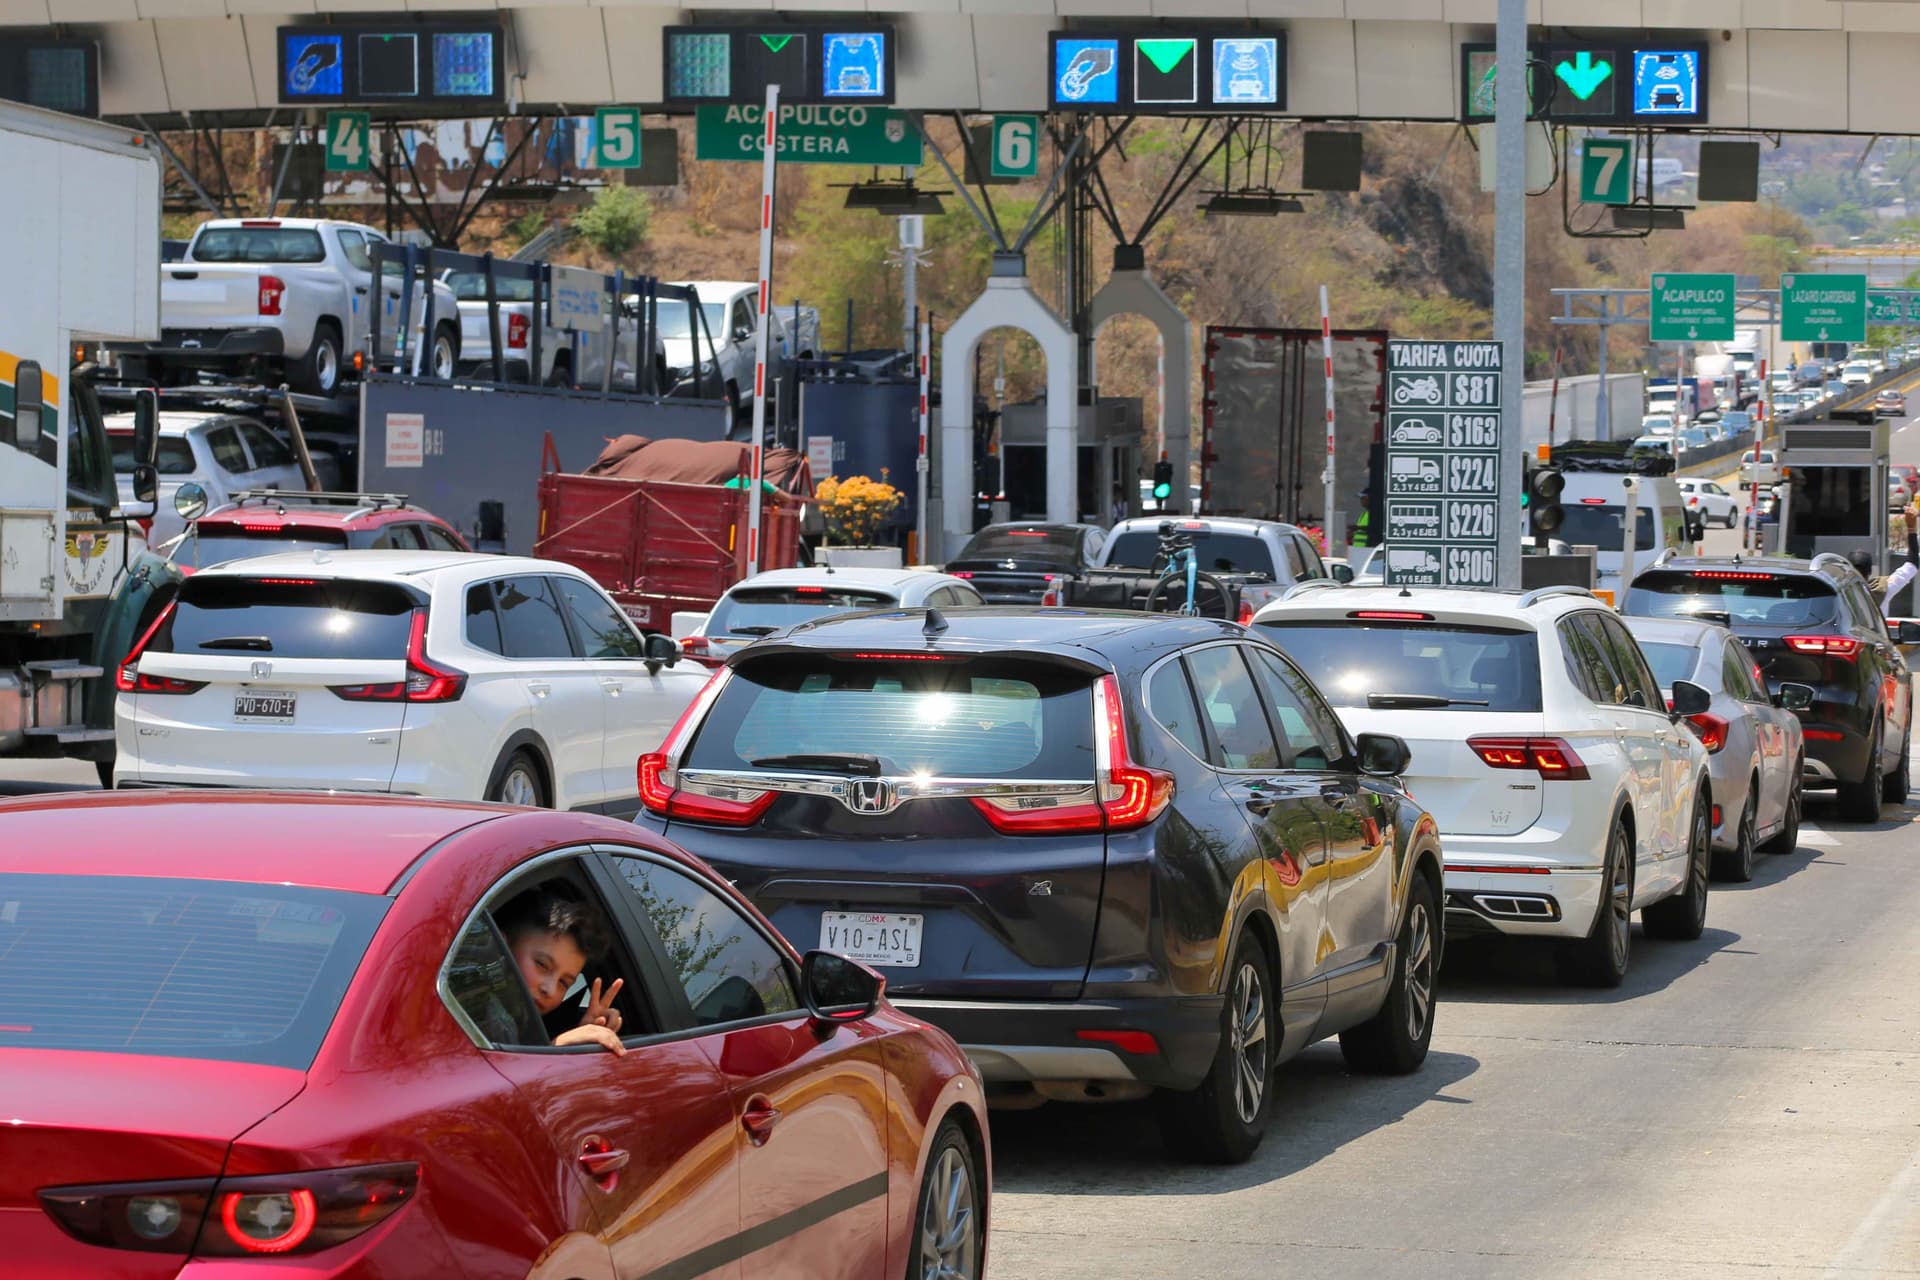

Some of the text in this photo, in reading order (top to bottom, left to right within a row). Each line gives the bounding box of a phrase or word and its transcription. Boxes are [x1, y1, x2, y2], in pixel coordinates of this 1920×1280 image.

[332, 118, 362, 165] 4
[603, 114, 634, 160] 5
[999, 121, 1032, 168] 6
[1589, 146, 1624, 196] 7
[1662, 289, 1725, 303] ACAPULCO
[1390, 345, 1500, 367] TARIFA CUOTA
[1455, 374, 1494, 405] $81
[1451, 415, 1496, 446] $163
[1401, 483, 1407, 491] 3
[1420, 483, 1439, 491] EJES
[1450, 456, 1494, 492] $224
[1400, 528, 1406, 536] 3
[1412, 528, 1418, 536] 4
[1419, 528, 1438, 537] EJES
[1450, 502, 1494, 537] $226
[1401, 575, 1408, 583] Y
[1414, 575, 1433, 583] EJES
[1449, 548, 1493, 584] $306
[235, 698, 294, 714] PVD-670-E
[858, 914, 887, 923] CDMX
[828, 926, 913, 951] V10-ASL
